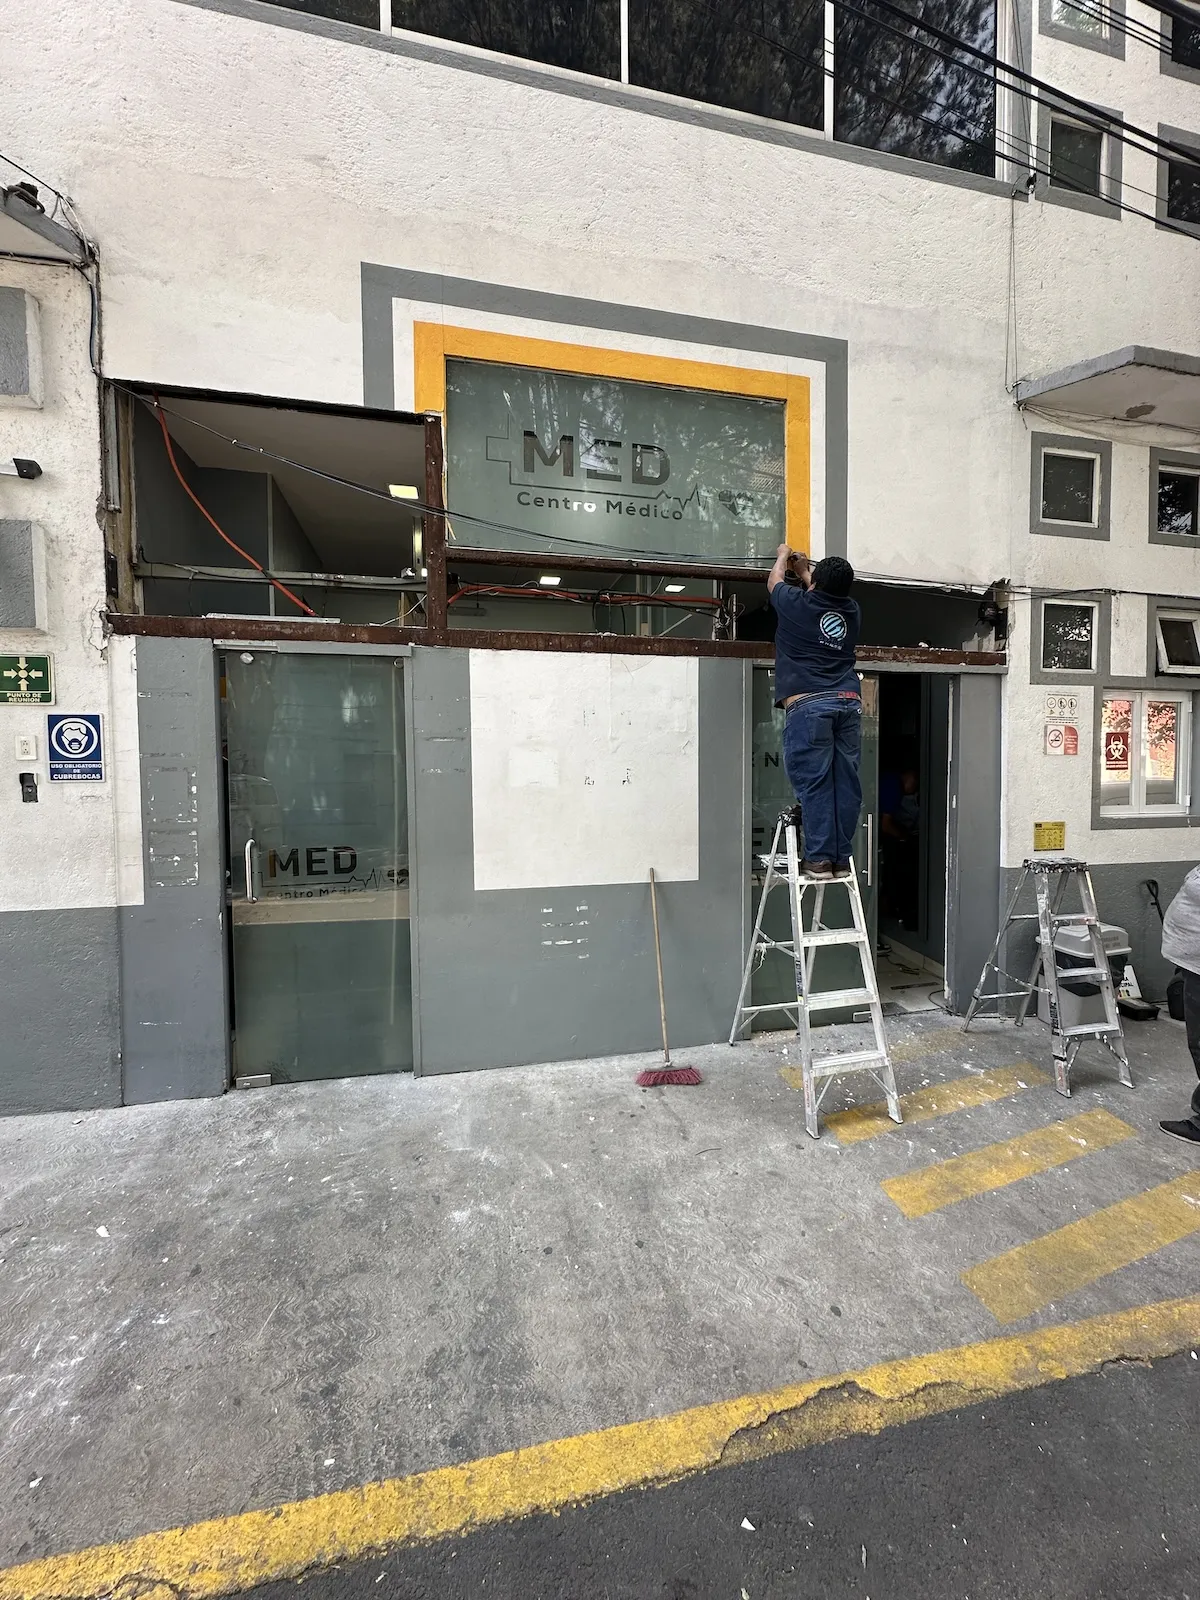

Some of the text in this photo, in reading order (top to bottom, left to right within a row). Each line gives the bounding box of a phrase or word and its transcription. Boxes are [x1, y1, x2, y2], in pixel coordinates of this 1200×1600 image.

[523, 430, 671, 486] MED
[517, 491, 683, 520] Centro Médico
[269, 846, 358, 878] MED
